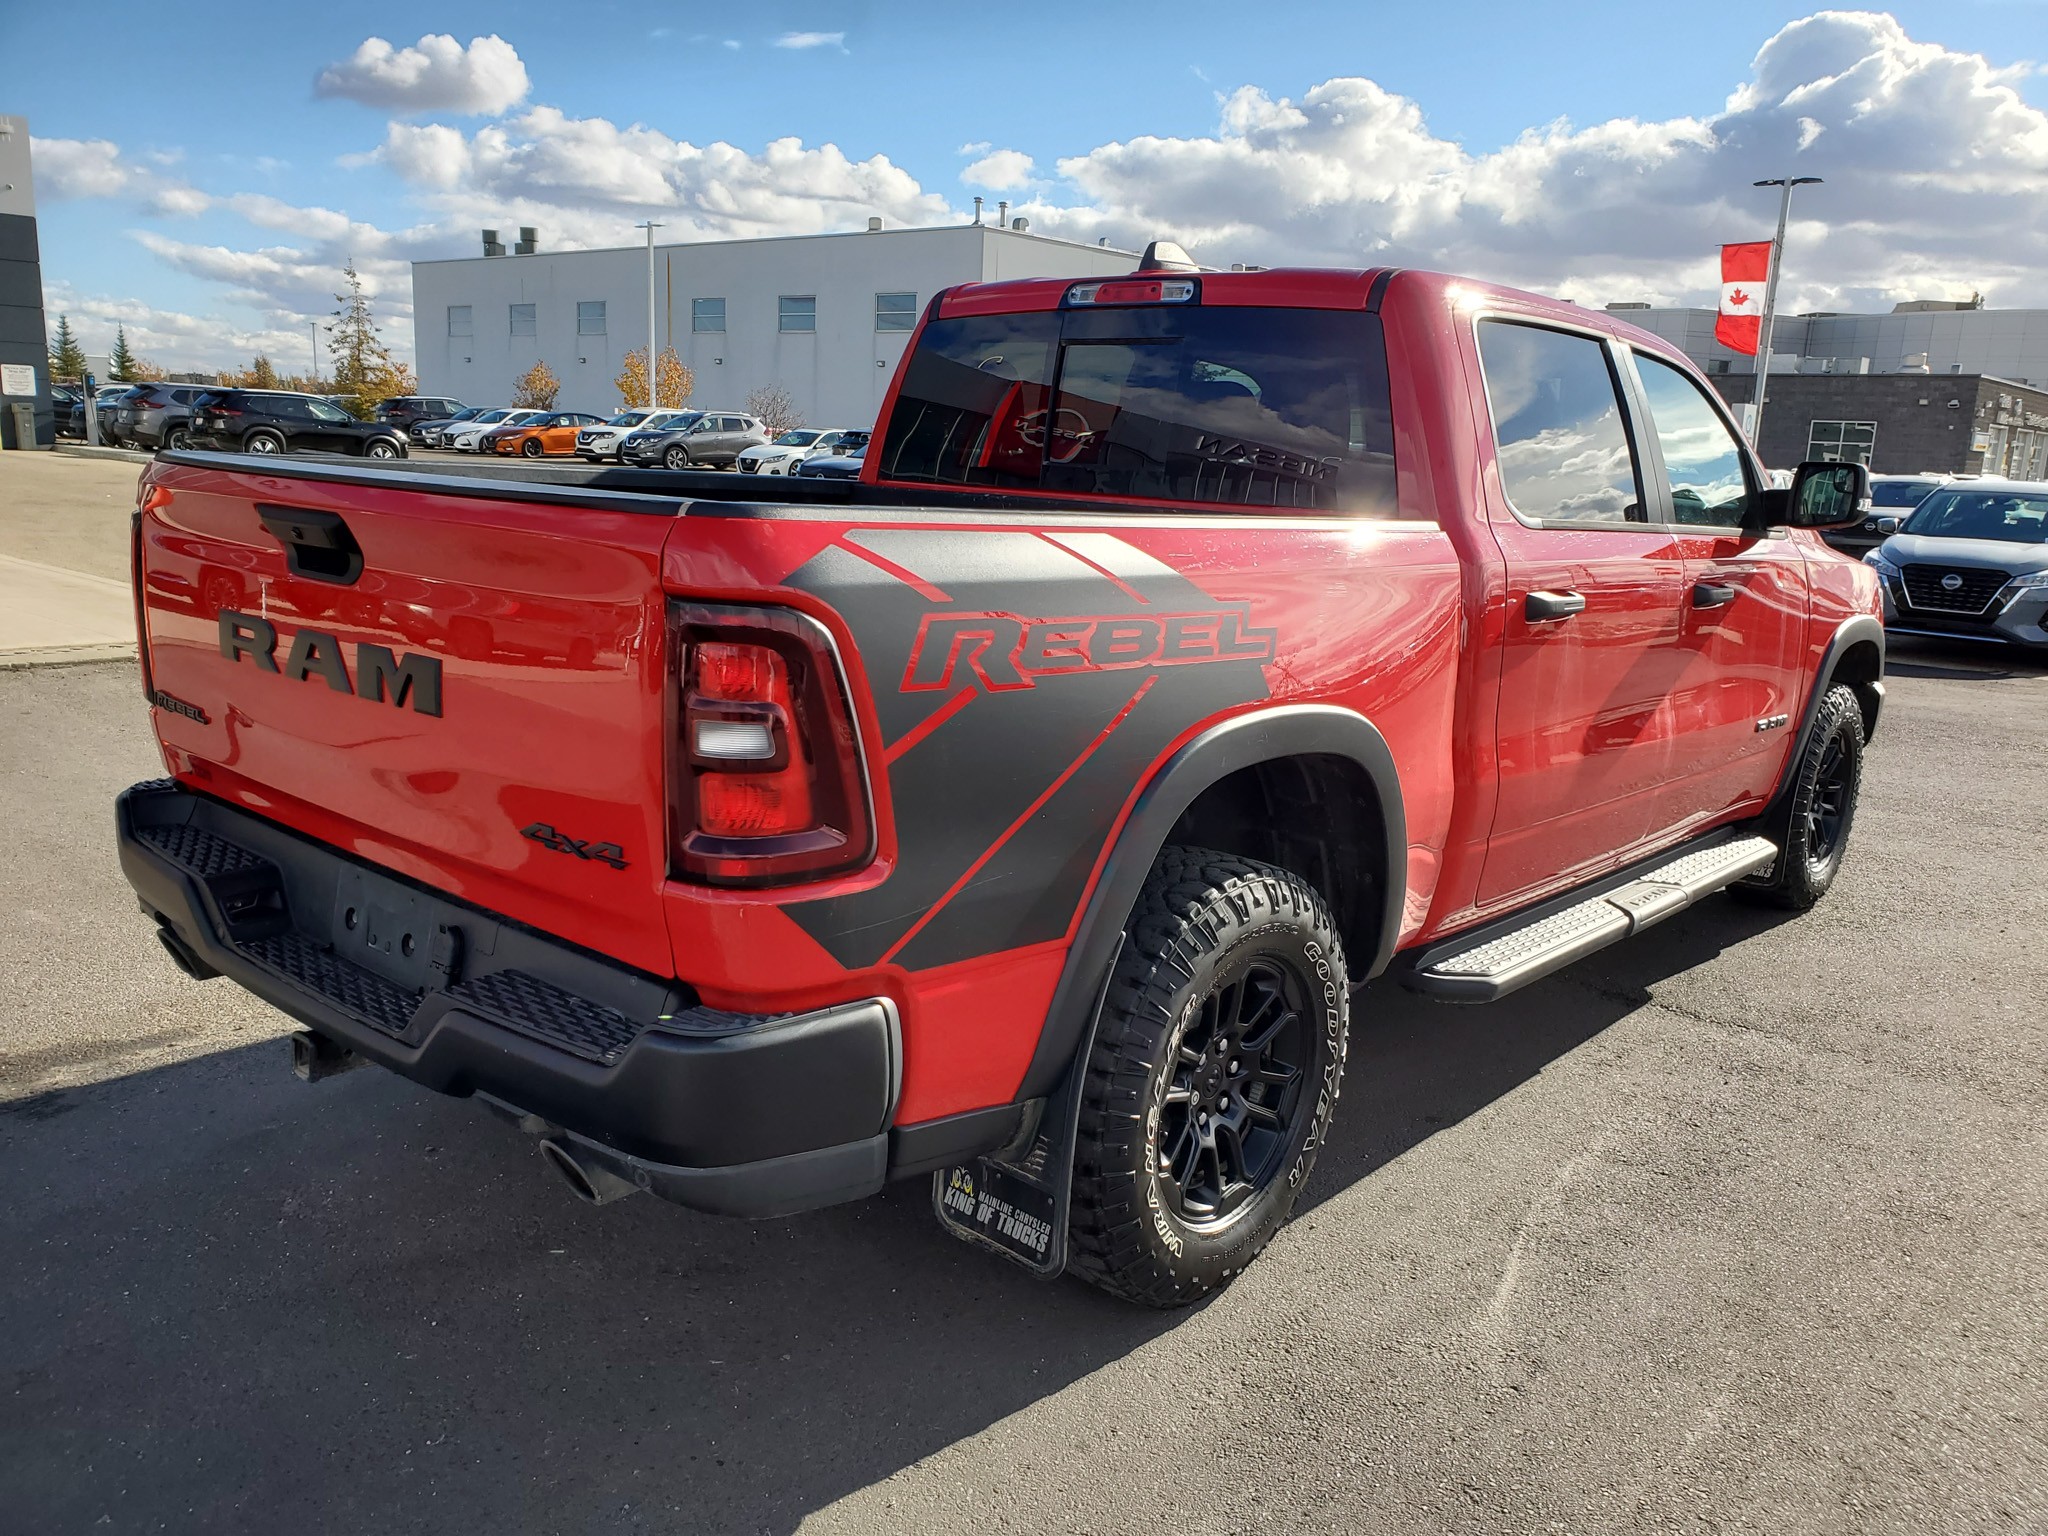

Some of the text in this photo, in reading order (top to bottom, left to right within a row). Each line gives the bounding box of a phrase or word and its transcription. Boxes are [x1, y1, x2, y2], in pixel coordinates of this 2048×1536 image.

[218, 608, 444, 718] RAM
[899, 608, 1277, 693] REBEL
[154, 690, 209, 725] REBEL
[1754, 714, 1788, 733] RAM
[1288, 941, 1339, 1188] GOODYEAR
[1145, 993, 1197, 1258] WRANGLER
[944, 1186, 1049, 1253] KING OF TRUCKS
[977, 1190, 1052, 1236] MAINLINE CHRYSLER
